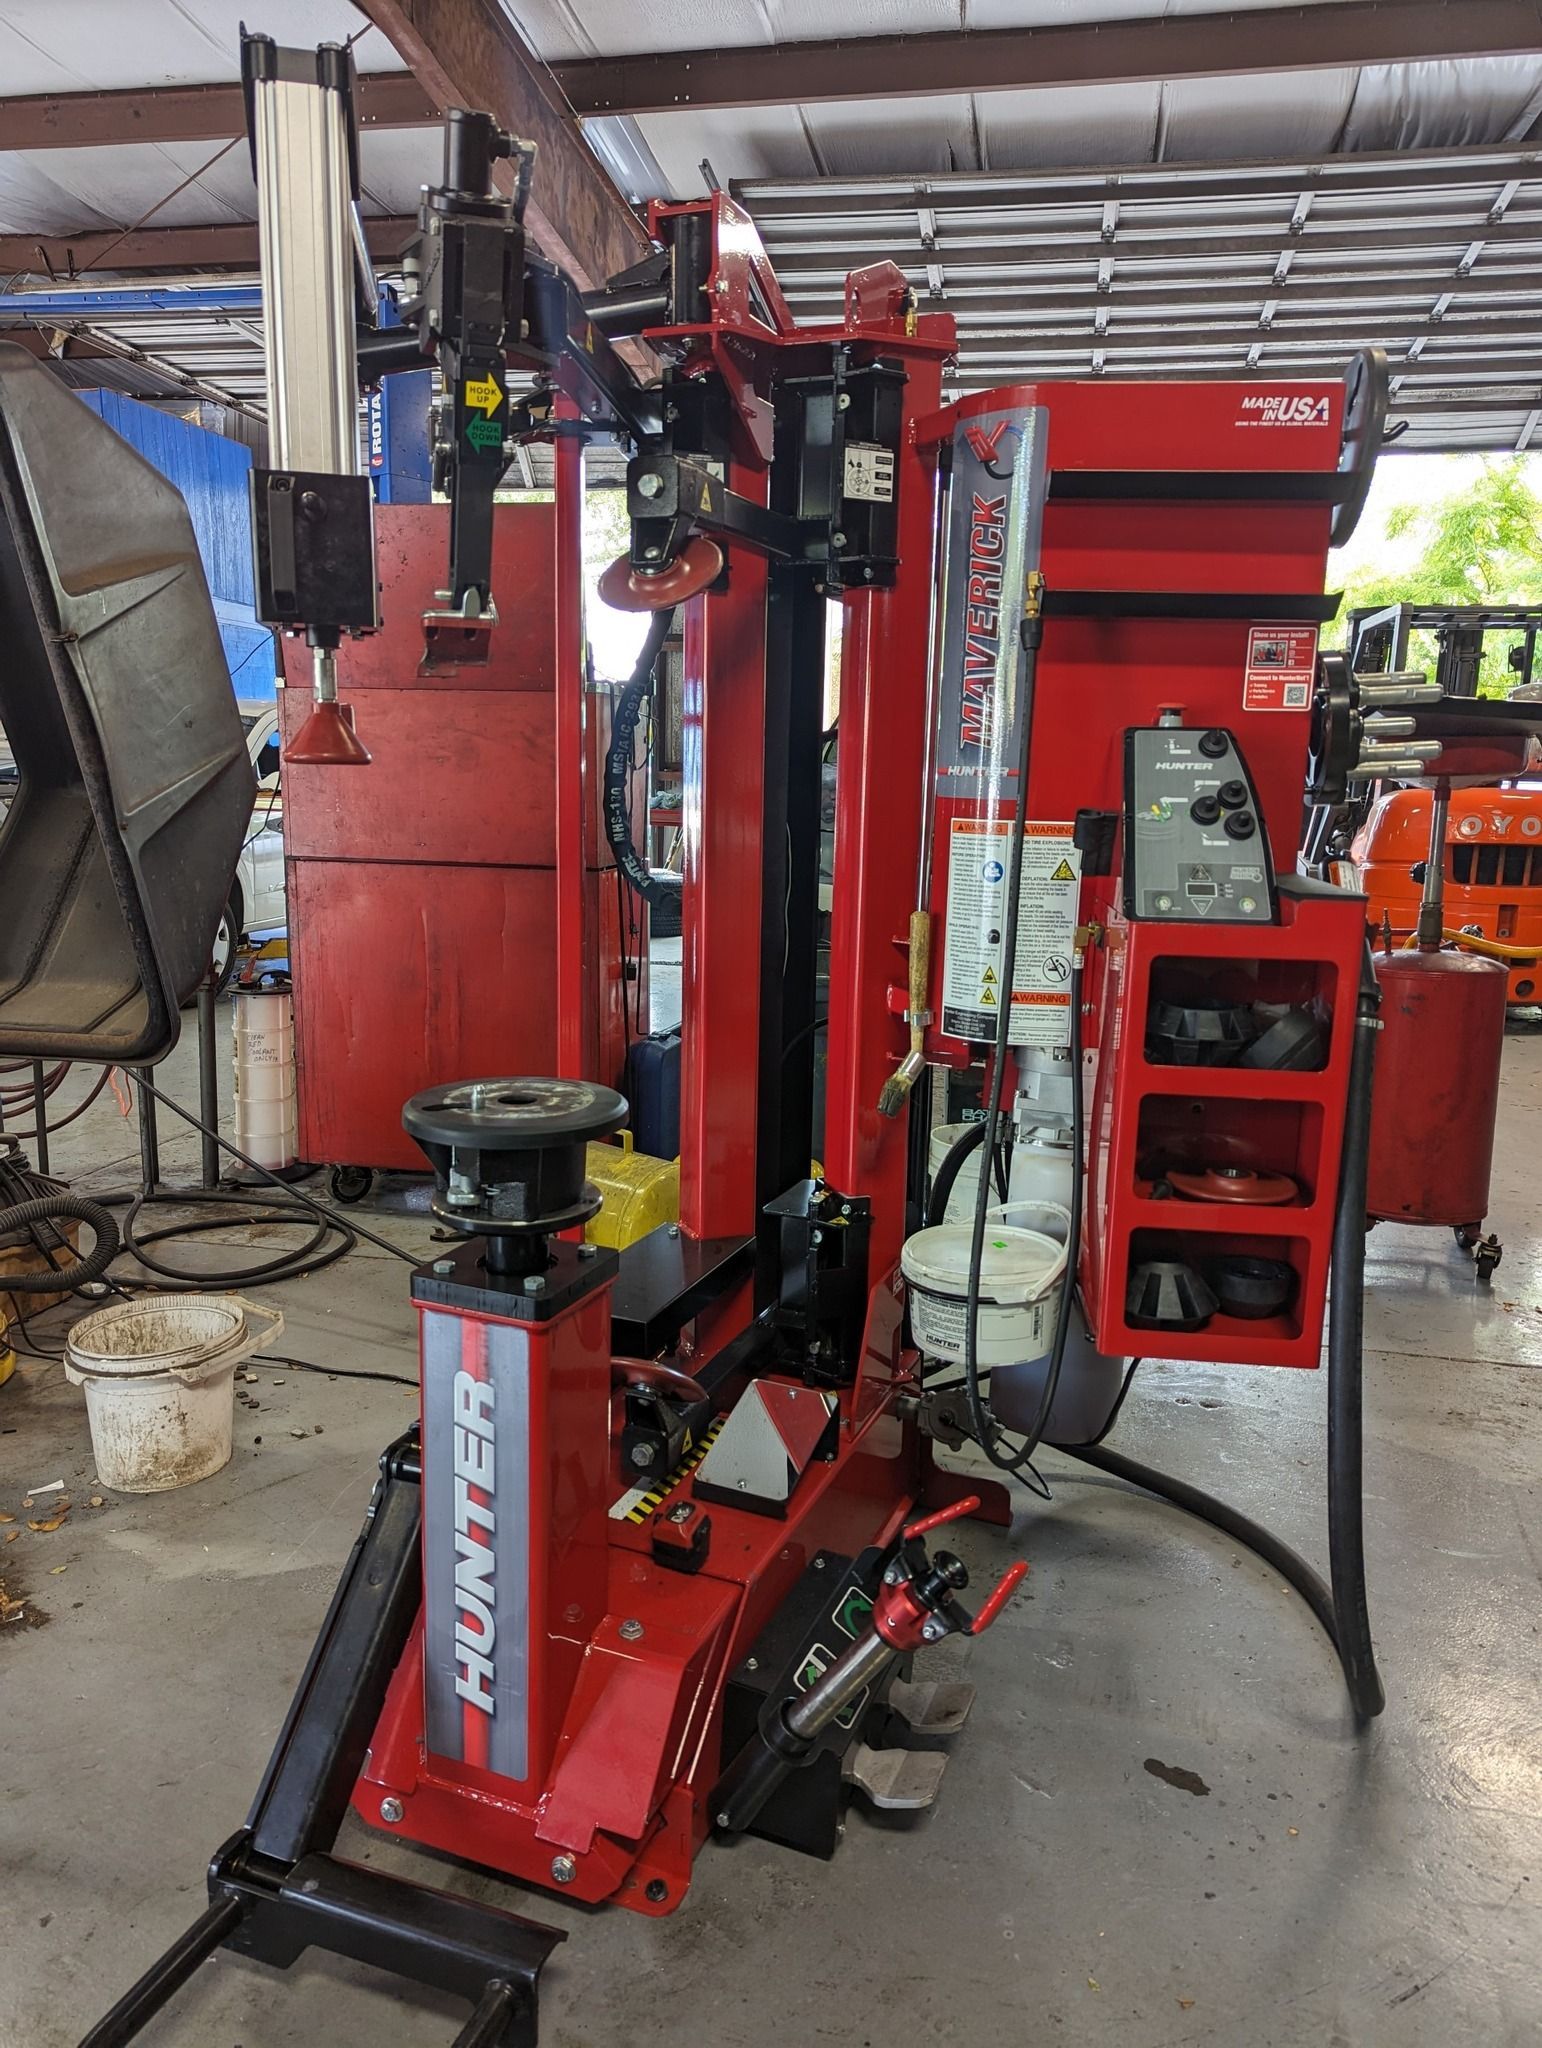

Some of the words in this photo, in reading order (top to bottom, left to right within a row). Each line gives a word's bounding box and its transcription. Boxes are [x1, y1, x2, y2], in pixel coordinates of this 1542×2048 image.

[470, 386, 498, 396] HOOK
[1241, 397, 1282, 409] MADE
[1277, 396, 1330, 421] USA
[1262, 409, 1278, 420] IN
[371, 392, 382, 454] ROTA
[472, 426, 500, 434] HOOK
[471, 433, 500, 441] DOWN
[961, 492, 1007, 750] MAVERICK
[1155, 762, 1214, 770] HUNTER
[1031, 825, 1075, 834] WARNING
[1460, 815, 1542, 836] OYO
[1019, 994, 1066, 1003] WARNING
[926, 1334, 960, 1349] HUNTER
[454, 1369, 496, 1716] HUNTER
